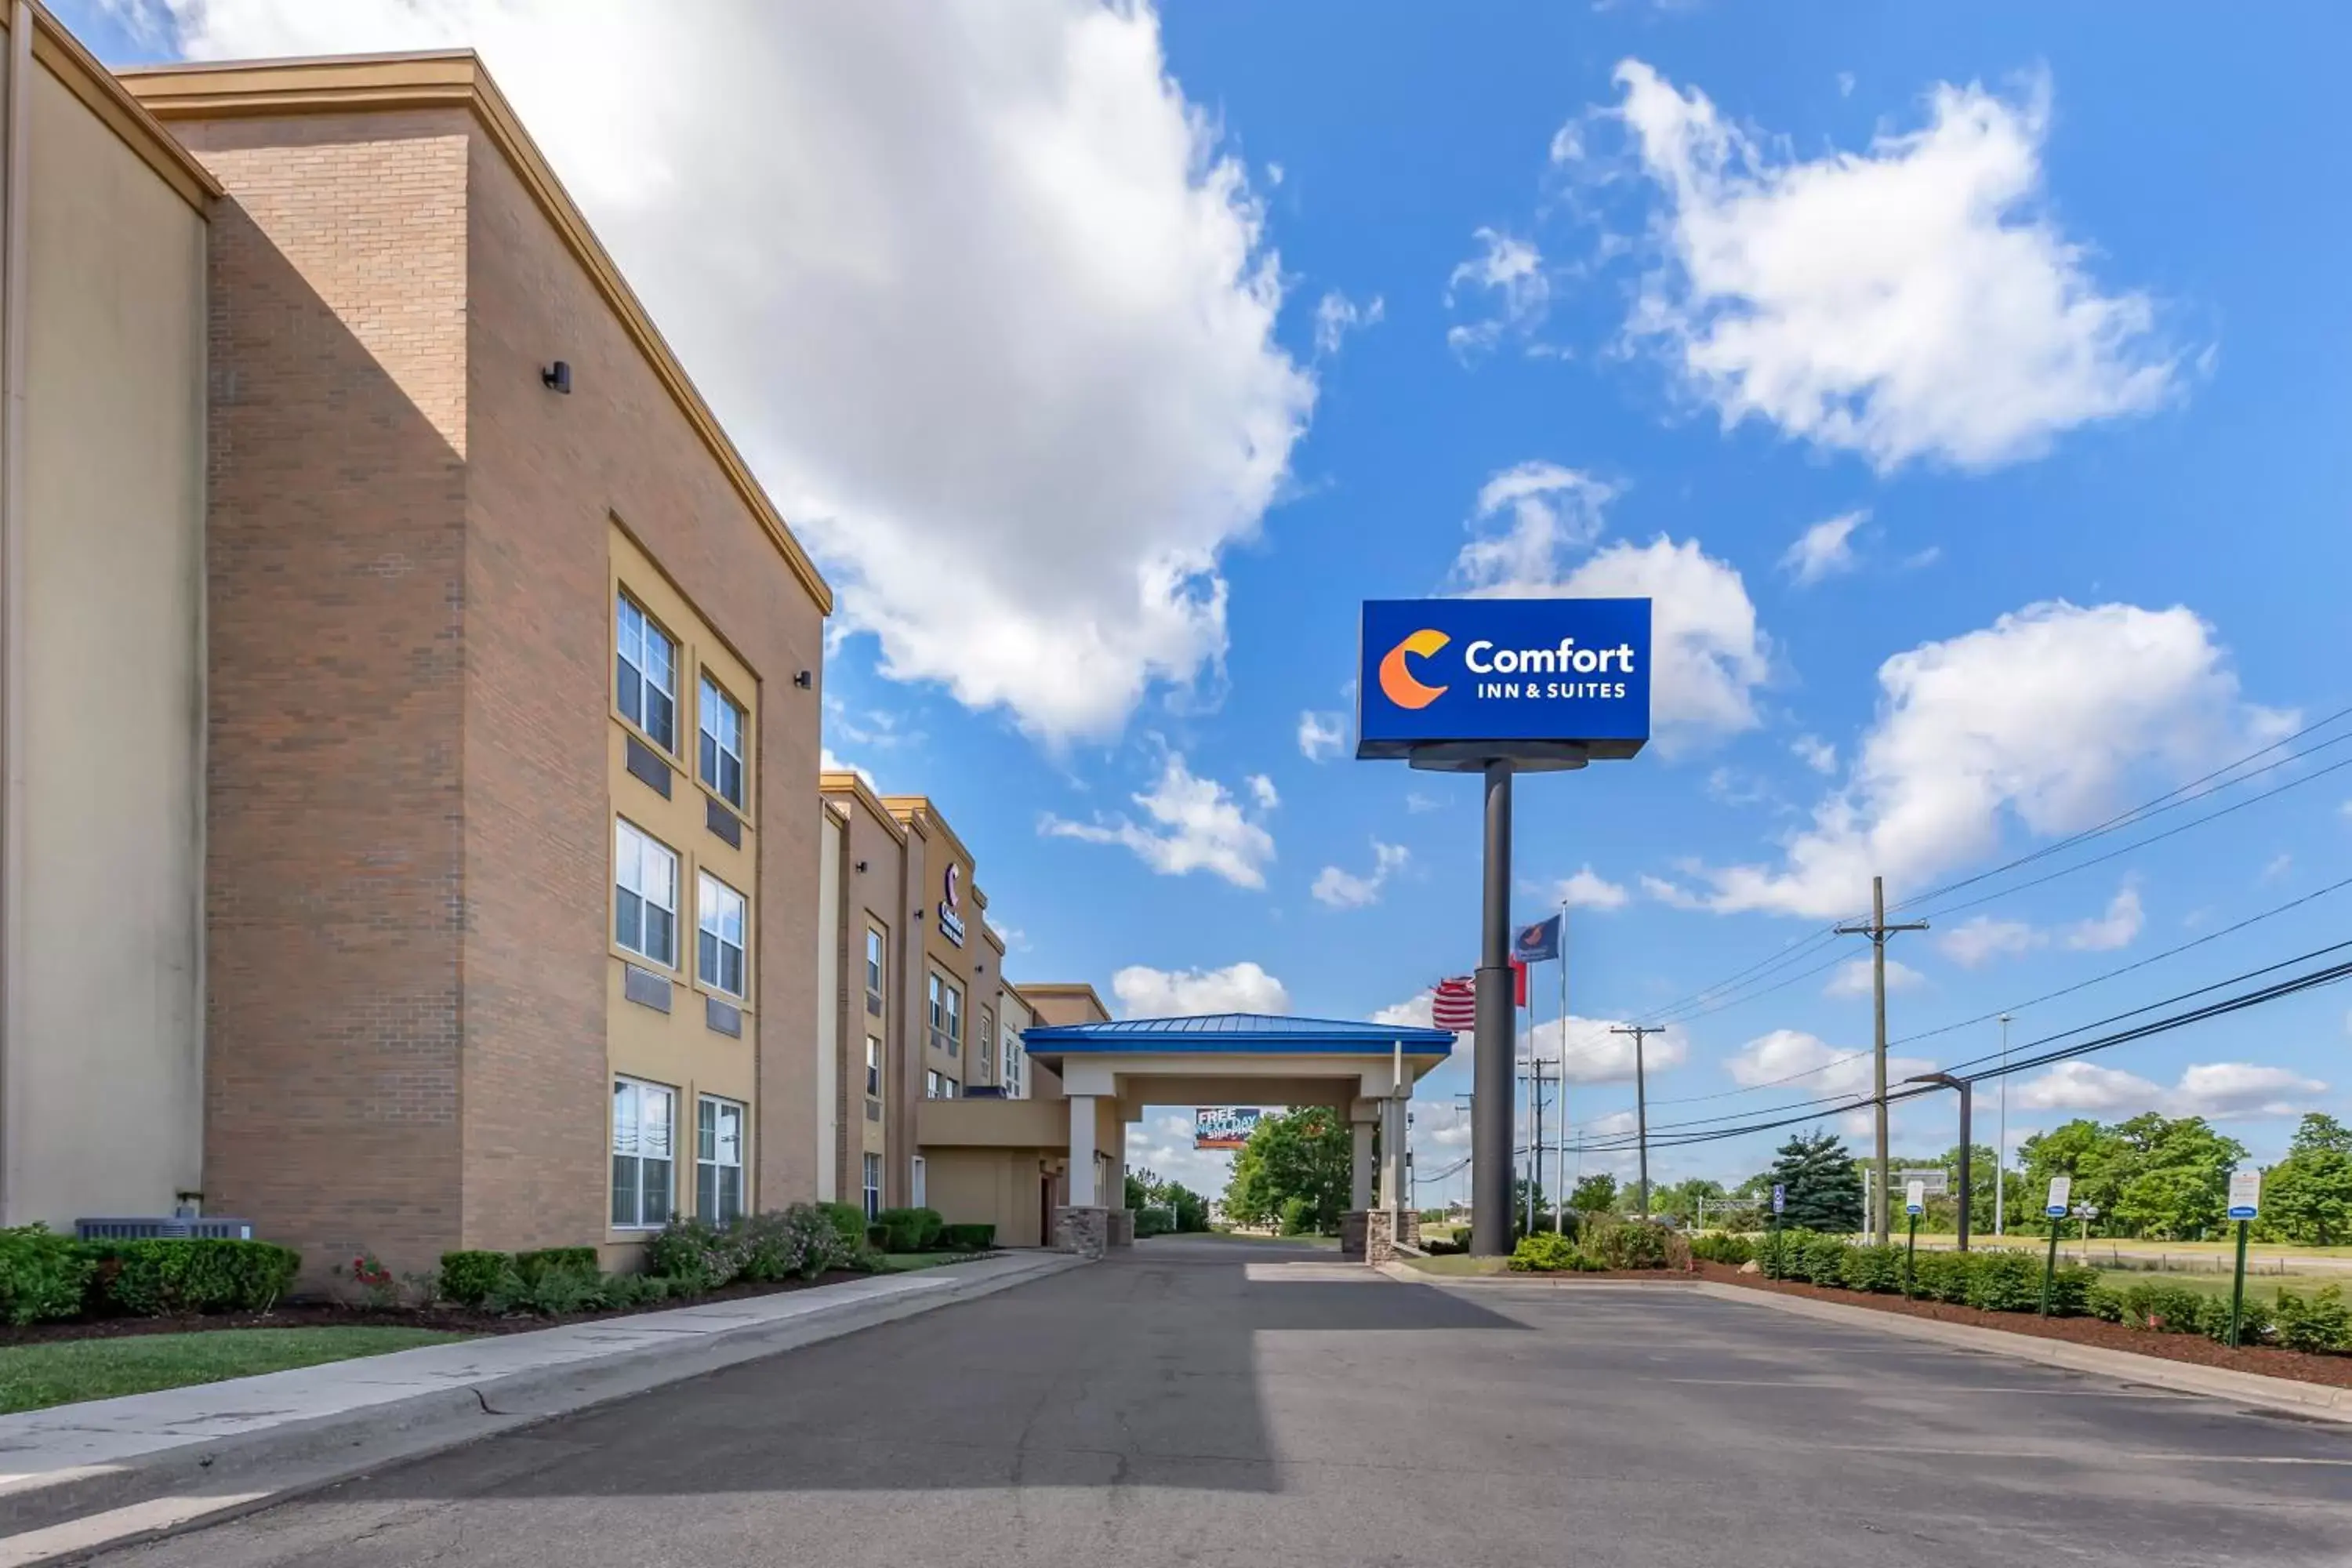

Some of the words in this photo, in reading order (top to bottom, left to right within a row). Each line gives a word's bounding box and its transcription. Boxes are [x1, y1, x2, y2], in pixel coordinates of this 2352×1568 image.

[1465, 637, 1635, 673] Comfort
[1478, 683, 1519, 699] INN
[1526, 683, 1541, 699] &
[1547, 683, 1626, 699] SUITES
[1195, 1119, 1229, 1134] NEXT
[1232, 1114, 1257, 1130] DAY
[1197, 1106, 1236, 1124] FREE
